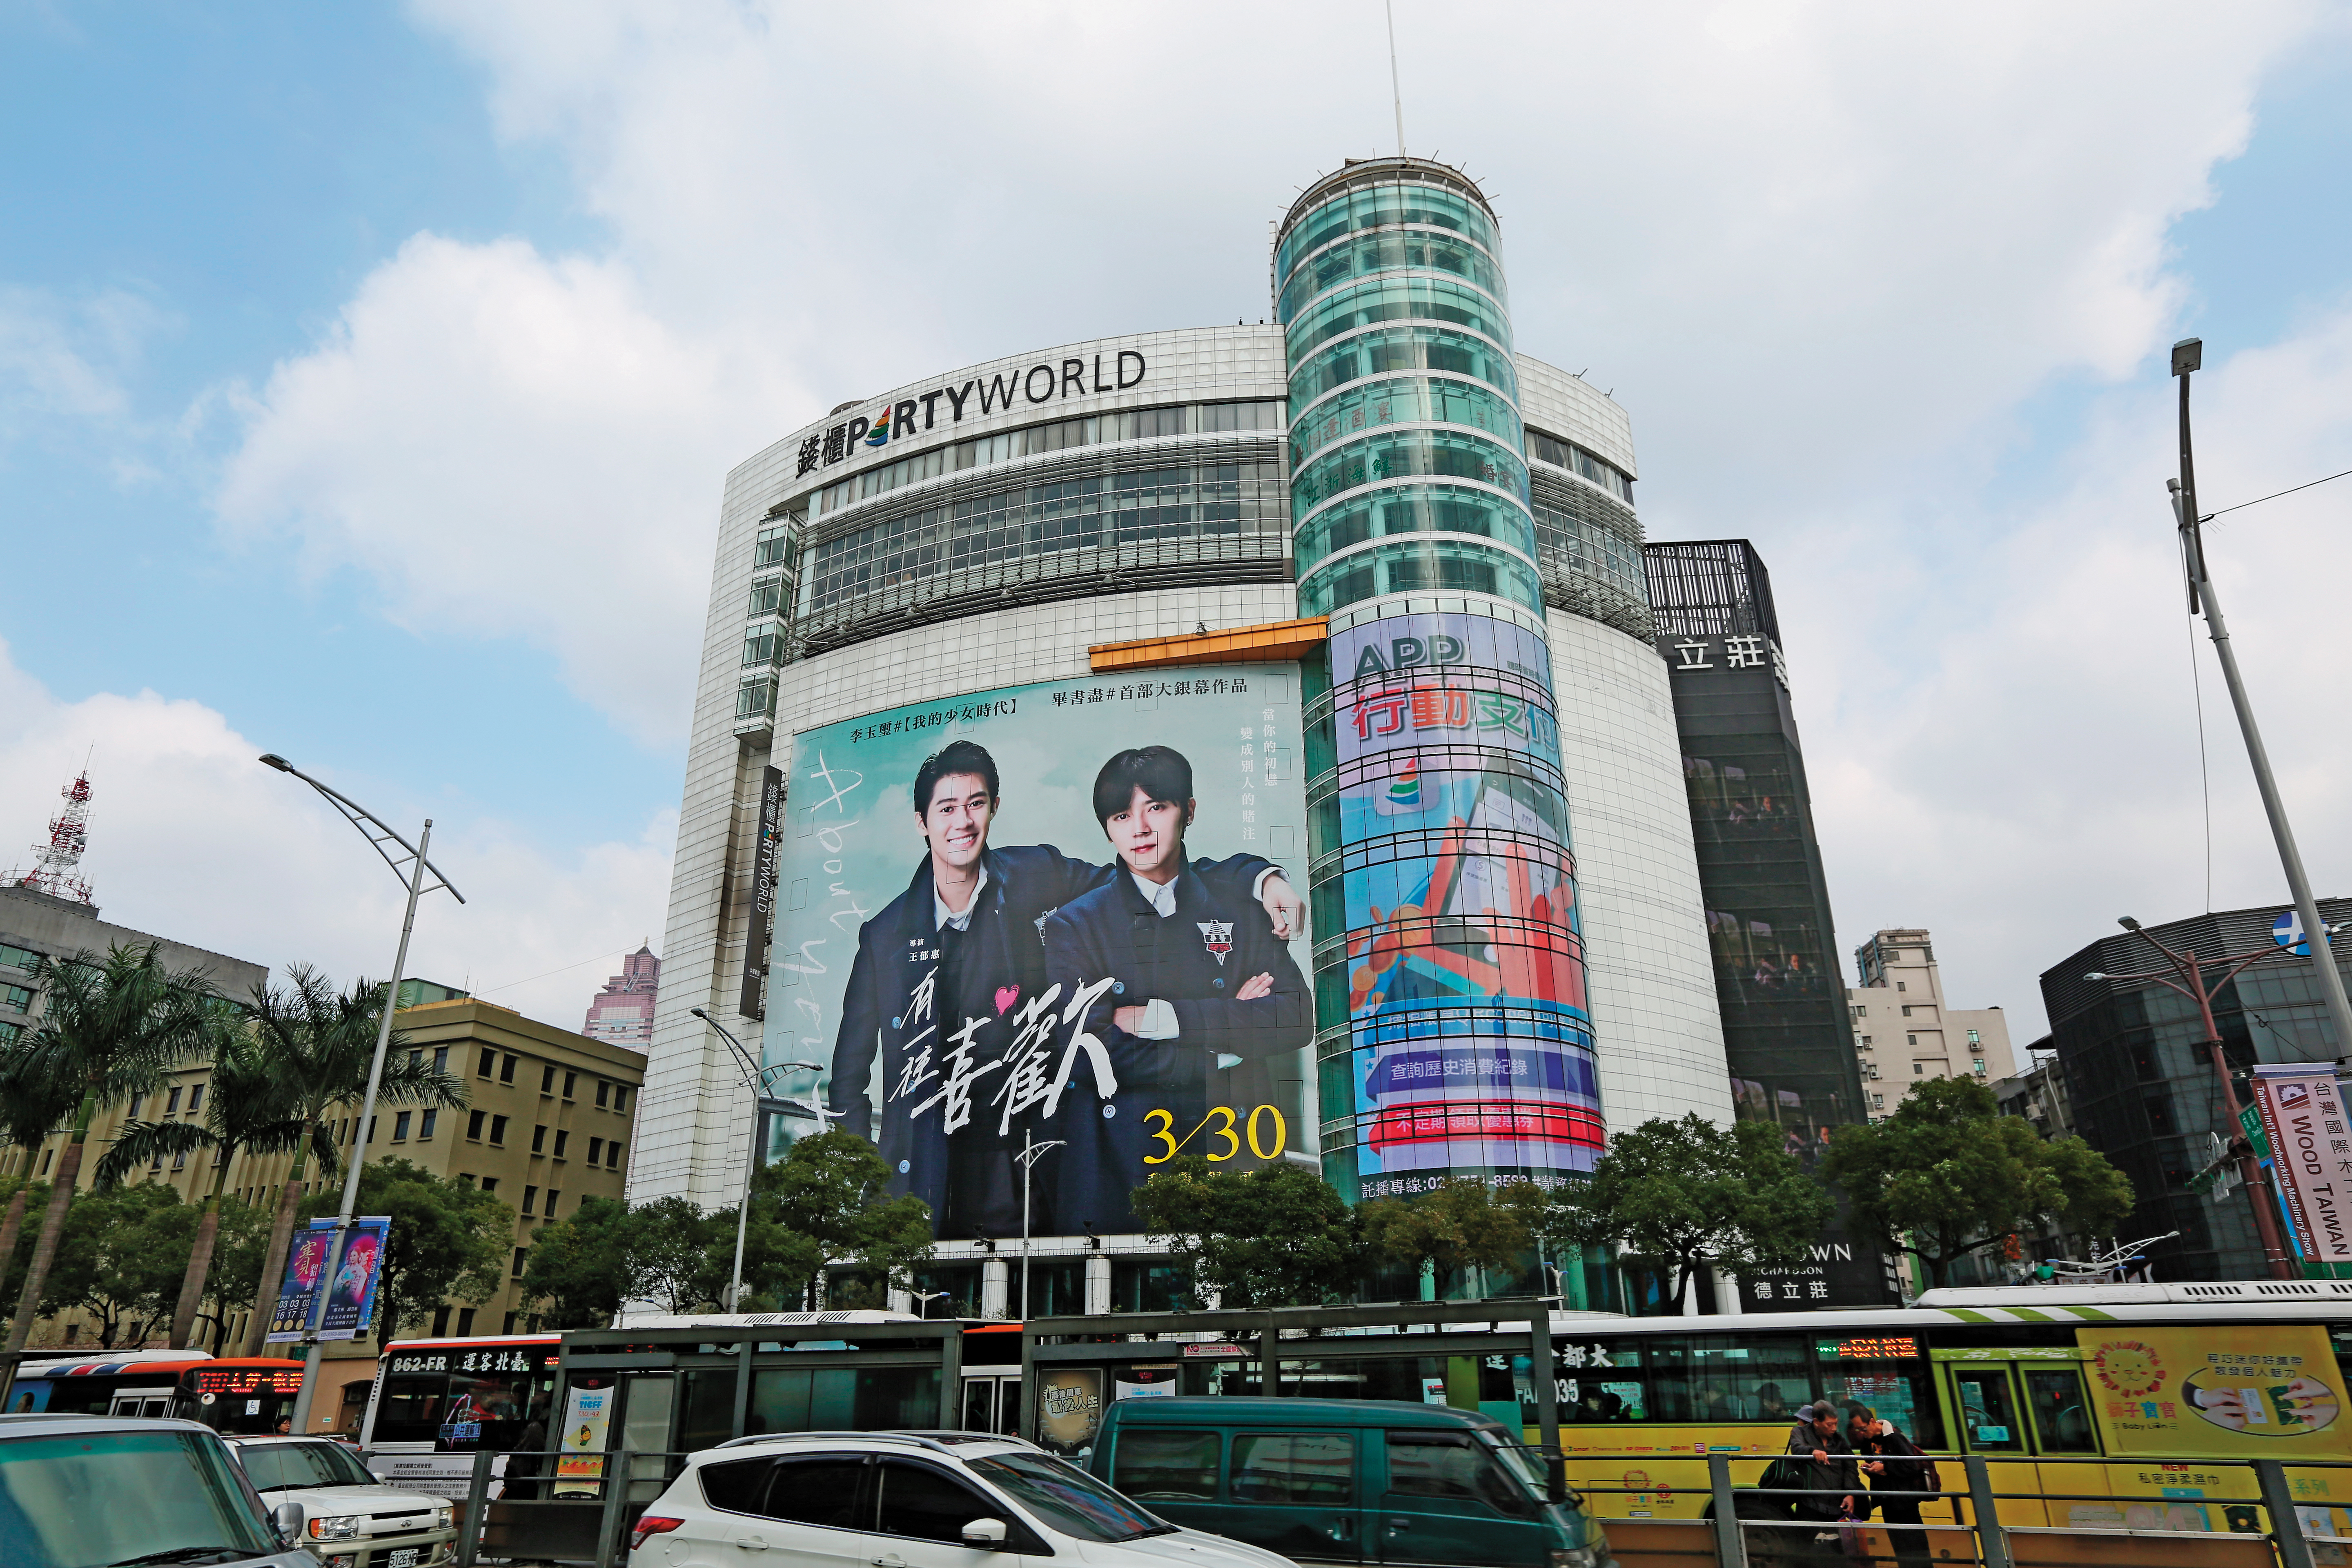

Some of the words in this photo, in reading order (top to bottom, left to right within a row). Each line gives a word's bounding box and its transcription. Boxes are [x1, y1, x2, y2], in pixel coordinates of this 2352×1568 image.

[1307, 456, 1393, 508] 江浙海鮮
[1352, 634, 1463, 690] APP
[1351, 683, 1557, 751] 行動支付
[1263, 708, 1278, 786] 當你的初戀
[1241, 727, 1256, 840] 變成別人的賭注
[1390, 1058, 1528, 1080] 查詢歷史消費紀錄
[2256, 1086, 2269, 1114] Taiwan
[2269, 1131, 2292, 1187] Woodworking
[2286, 1187, 2306, 1231] Machinery
[2301, 1232, 2314, 1256] Show
[2291, 1115, 2322, 1175] WOOD
[2312, 1183, 2350, 1255] TAIWAN
[279, 1300, 288, 1308] 03
[290, 1299, 300, 1307] 03
[302, 1299, 310, 1307] 03
[1754, 1281, 1828, 1299] 德立莊
[276, 1311, 285, 1319] 16
[300, 1310, 307, 1318] 18
[393, 1356, 447, 1372] 862-FR
[1051, 1394, 1099, 1414] 最後人生
[2122, 1423, 2145, 1431] Baby
